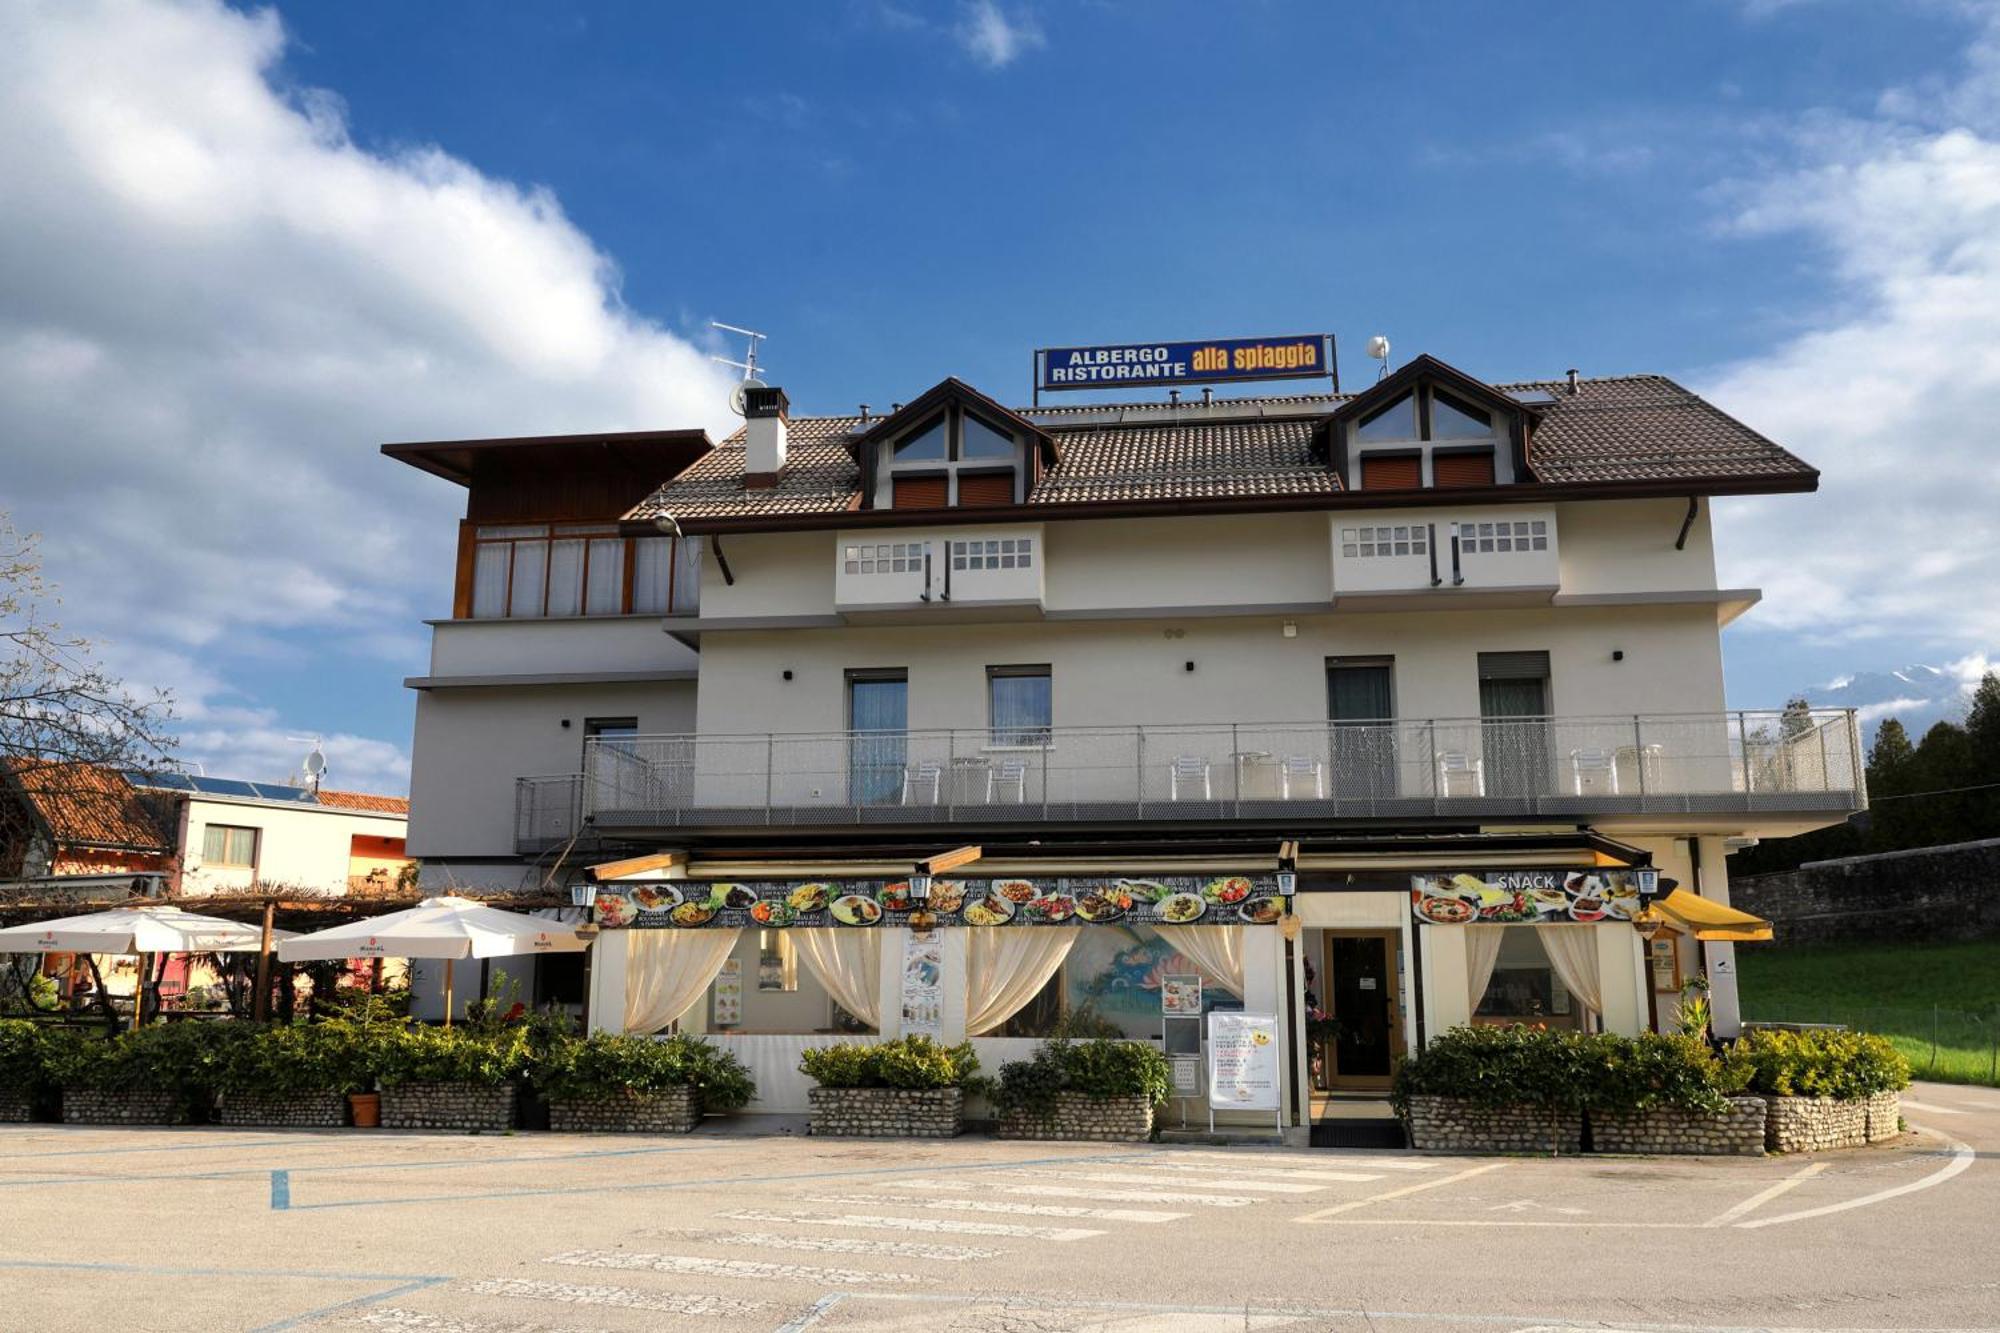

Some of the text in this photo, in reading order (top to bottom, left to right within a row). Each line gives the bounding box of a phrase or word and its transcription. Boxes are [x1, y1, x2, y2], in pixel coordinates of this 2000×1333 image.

[1069, 347, 1168, 366] ALBERGO
[1192, 342, 1316, 371] alla spiaggia
[1053, 362, 1186, 381] RISTORANTE
[1498, 876, 1555, 889] SNACK
